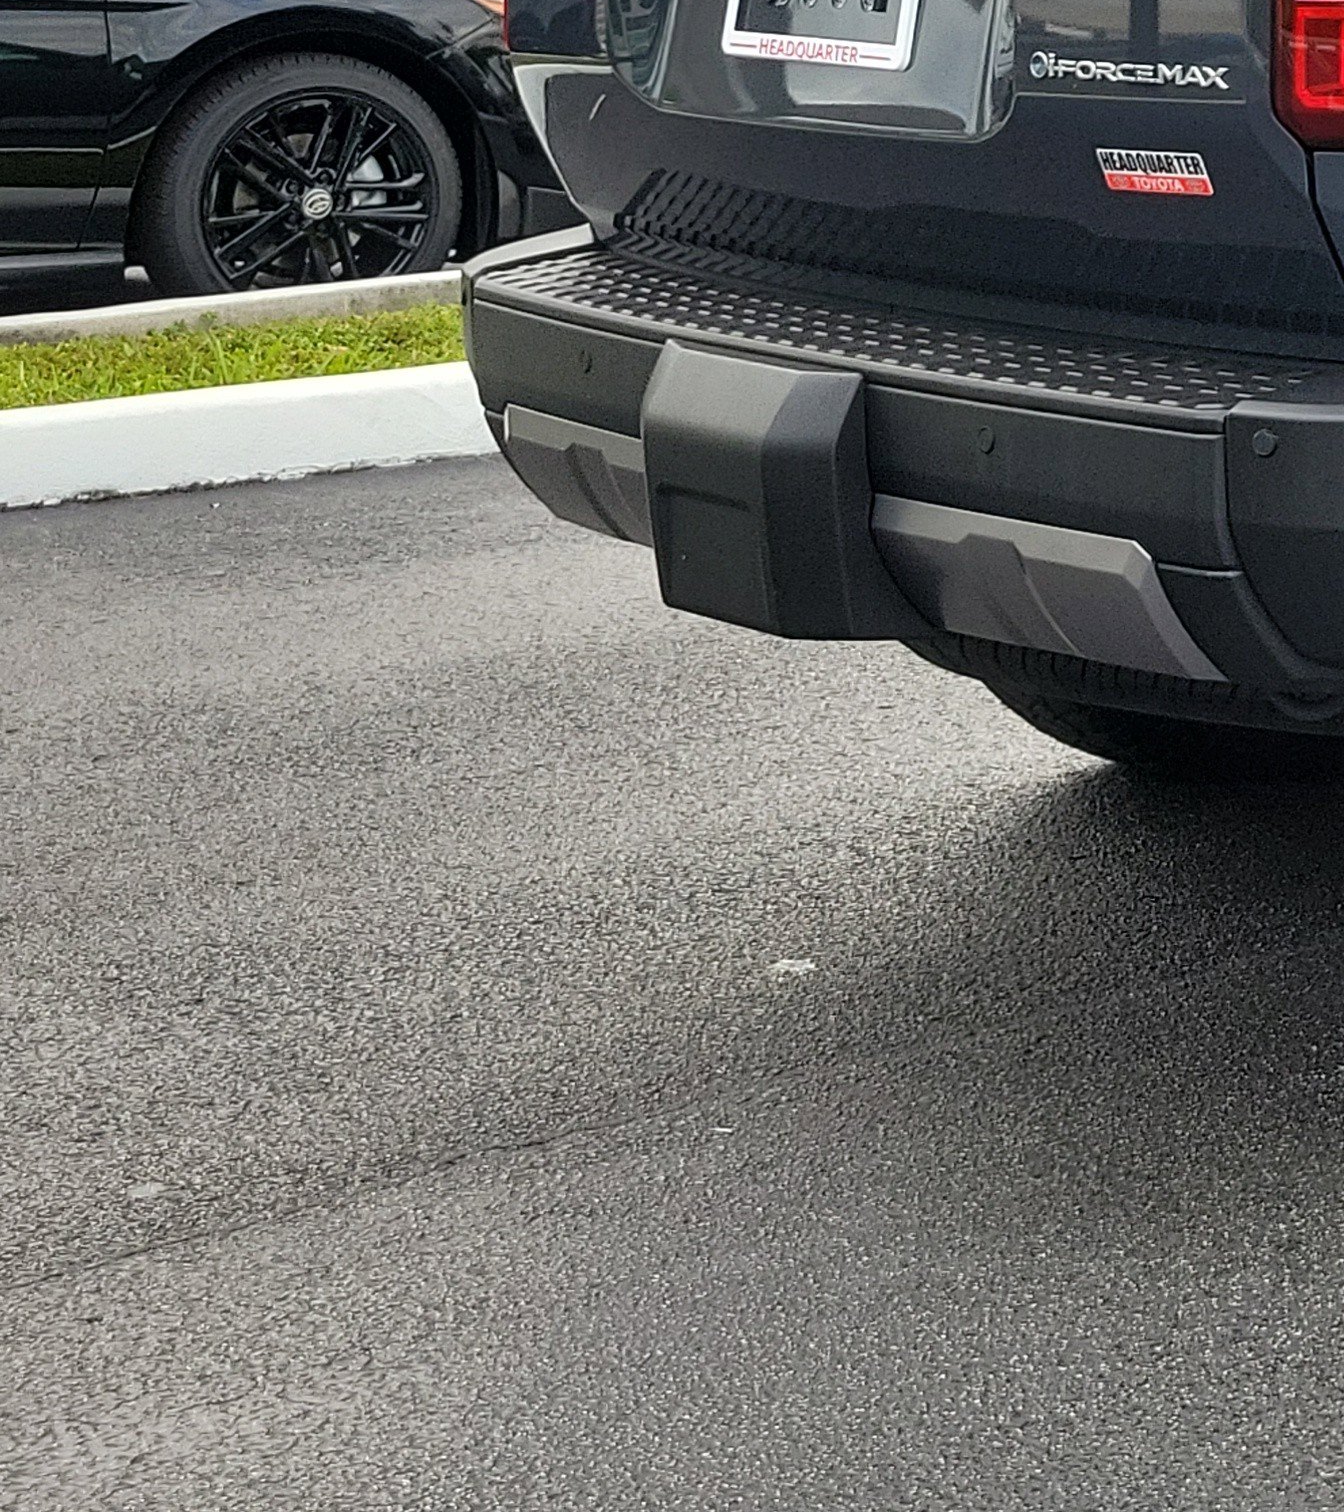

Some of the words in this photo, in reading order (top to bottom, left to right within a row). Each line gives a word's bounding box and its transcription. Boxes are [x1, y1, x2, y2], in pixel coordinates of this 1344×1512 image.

[758, 37, 859, 64] HEADQUARTER
[1099, 150, 1205, 177] HEADQUARTER
[1133, 177, 1184, 192] TOYOTA
